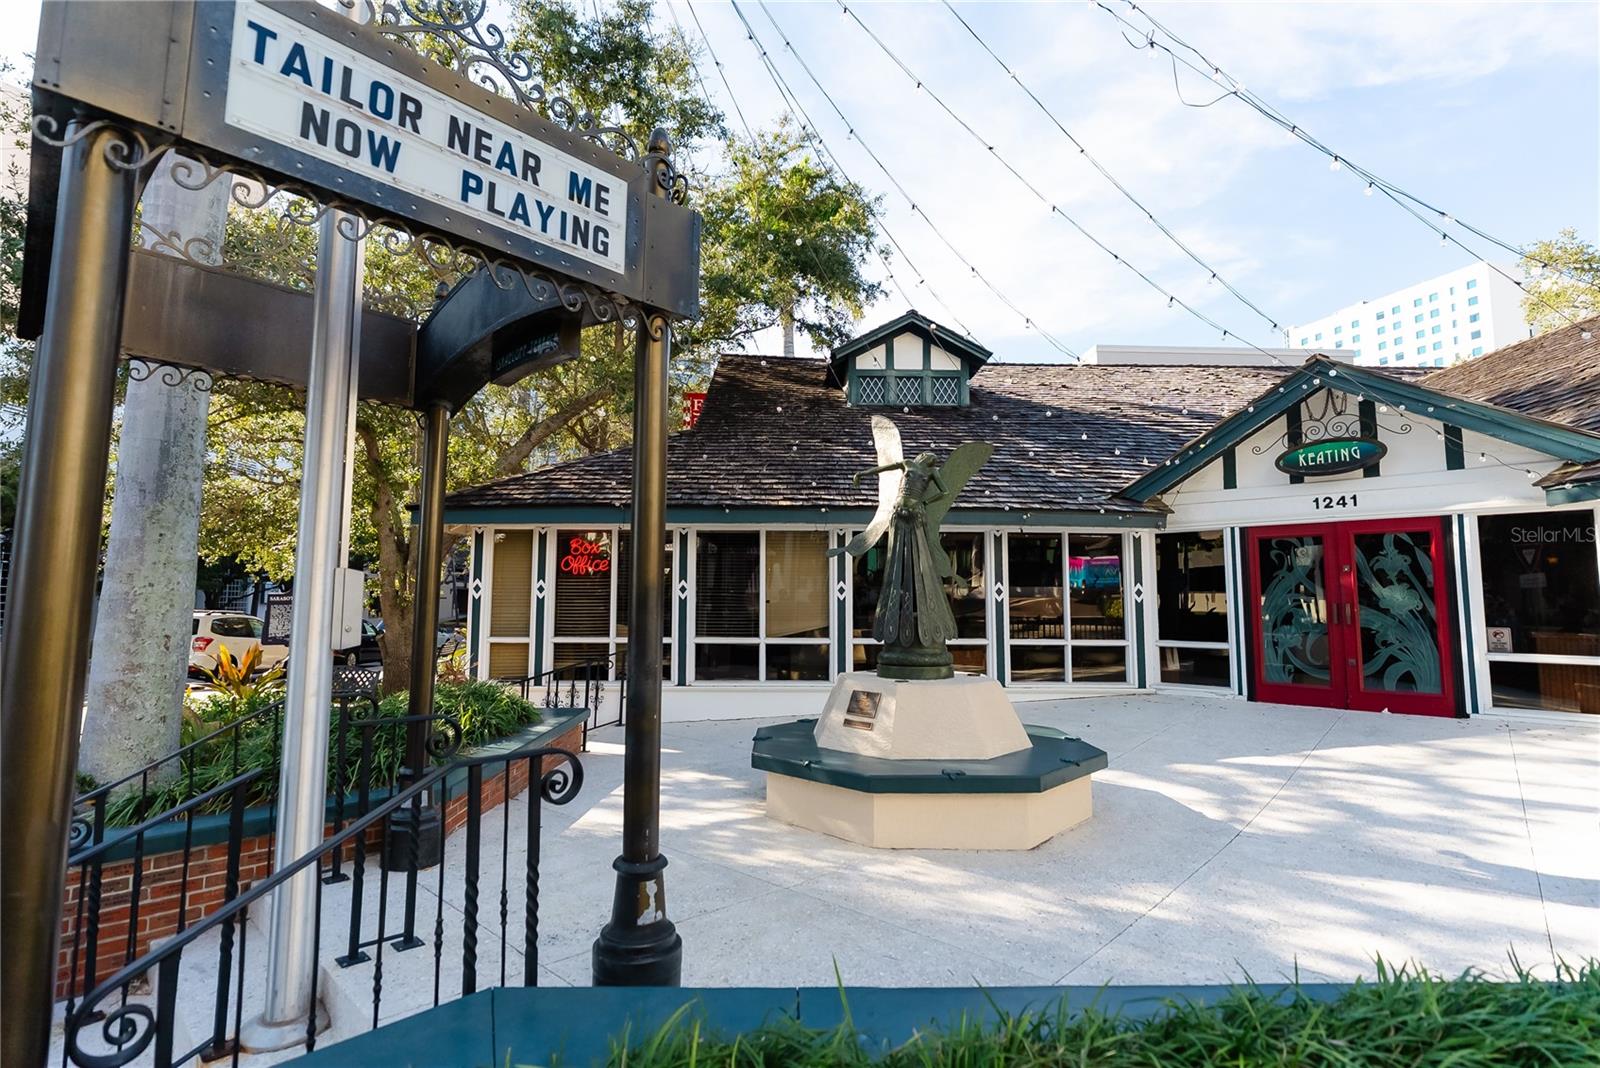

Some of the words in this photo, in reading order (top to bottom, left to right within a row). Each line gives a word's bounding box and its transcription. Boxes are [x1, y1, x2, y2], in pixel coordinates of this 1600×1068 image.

[247, 19, 423, 135] TAILOR
[447, 114, 542, 187] NEAR
[568, 171, 610, 217] ME
[300, 101, 402, 173] NOW
[461, 169, 609, 257] PLAYING
[1298, 446, 1360, 467] KEATING
[1312, 494, 1358, 510] 1241
[570, 538, 601, 555] Box
[561, 555, 609, 575] Office
